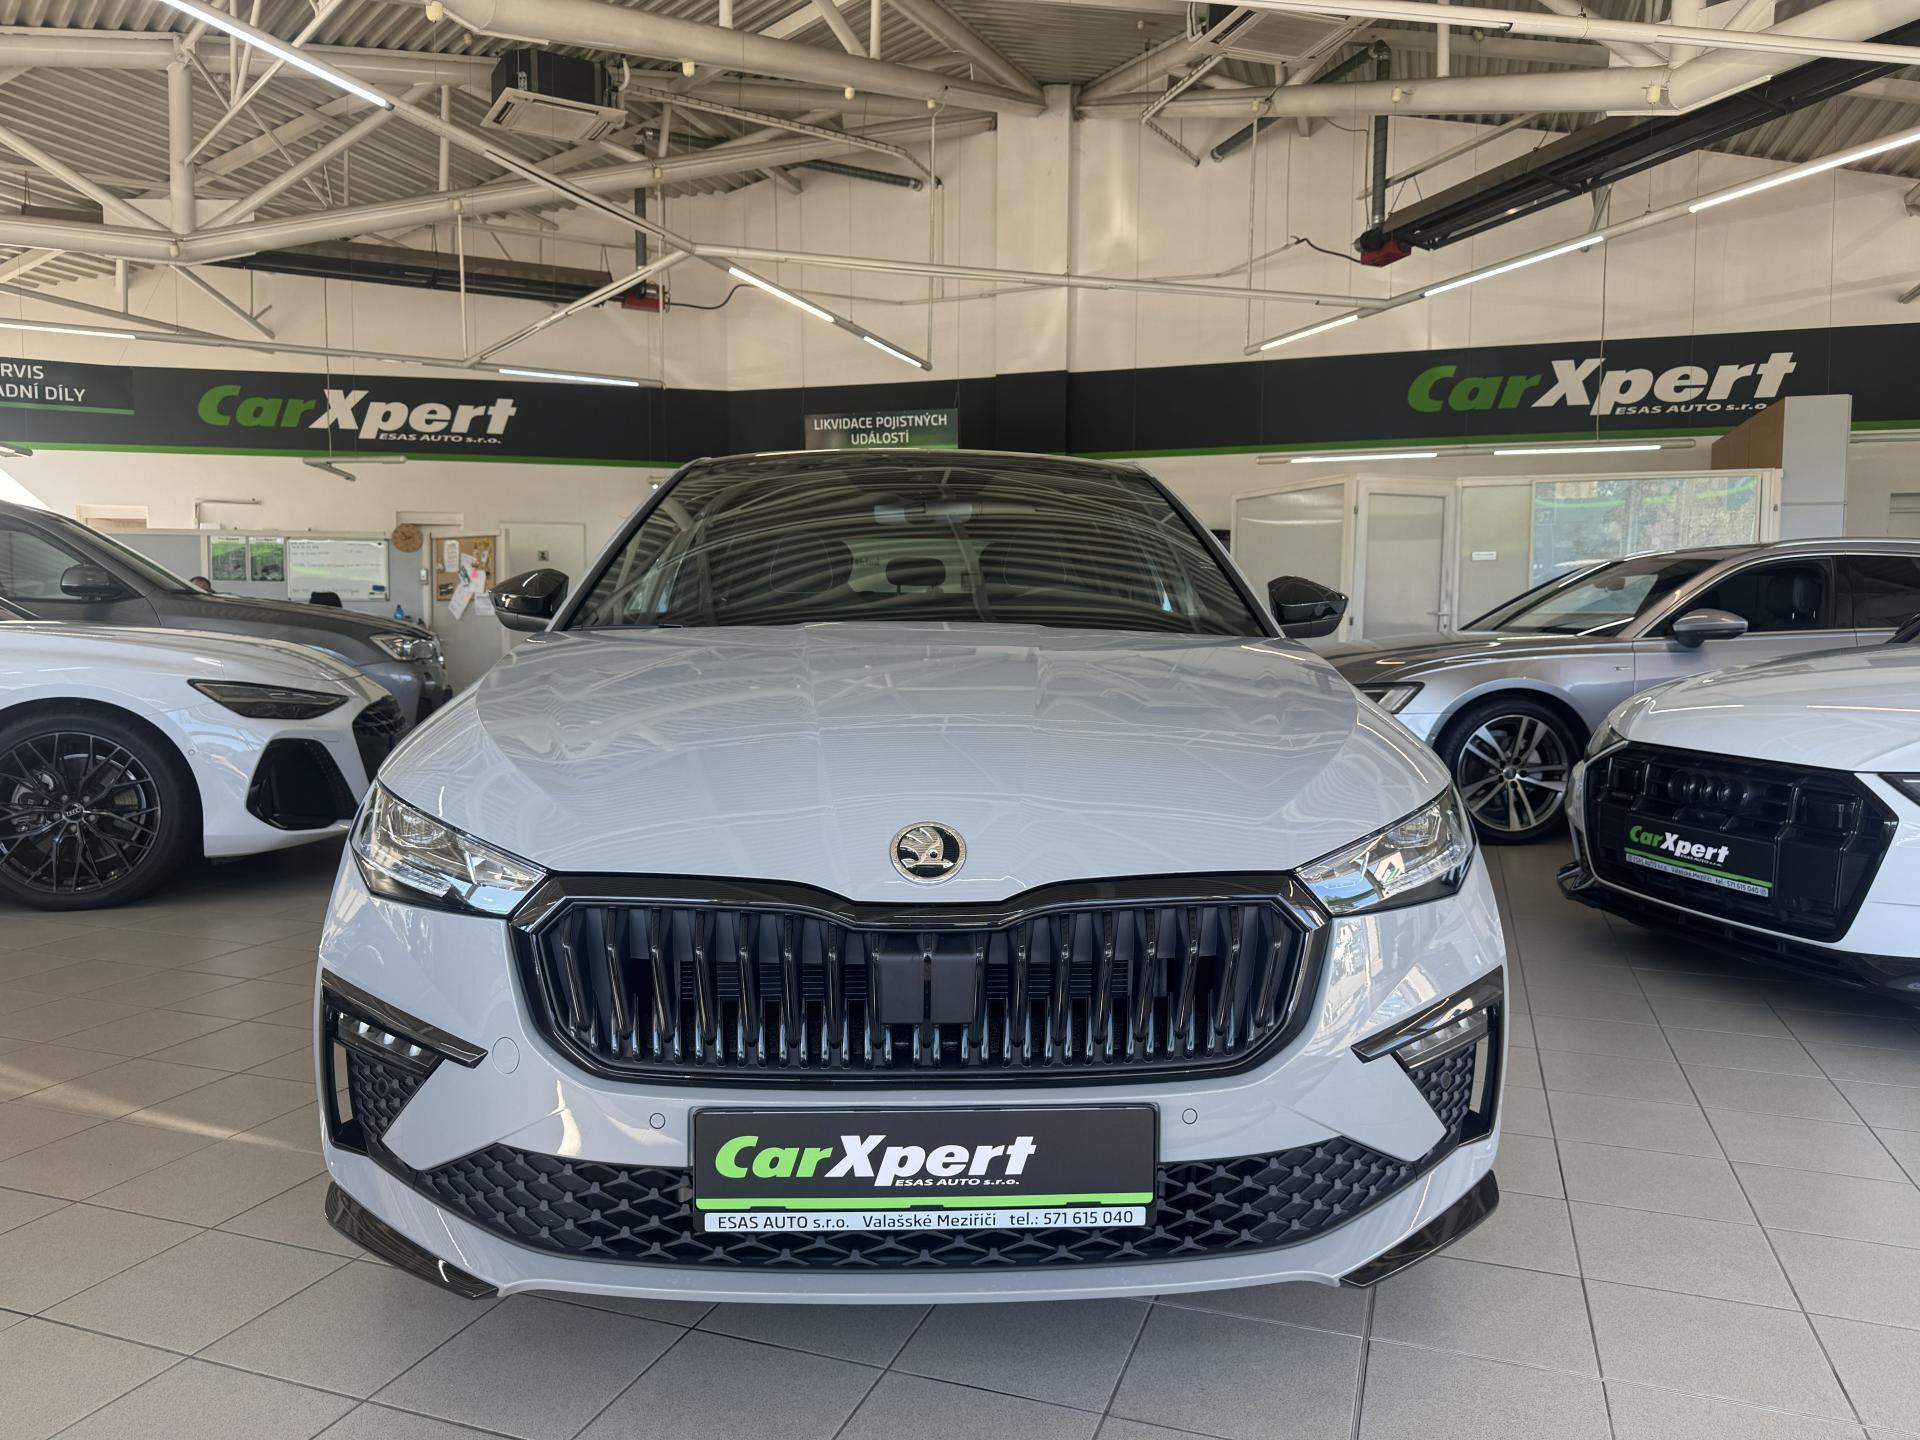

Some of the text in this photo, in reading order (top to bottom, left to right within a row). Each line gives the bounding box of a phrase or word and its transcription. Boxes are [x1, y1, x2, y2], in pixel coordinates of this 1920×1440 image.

[1407, 352, 1797, 416] CarXpert
[45, 385, 86, 402] DÍLY
[197, 384, 518, 440] CarXpert
[1615, 404, 1662, 415] ESAS
[1666, 403, 1721, 414] AUTO
[814, 412, 948, 431] LIKVIDACE POJISTNÝCH
[379, 432, 501, 444] ESAS AUTO s.r.o.
[851, 430, 909, 445] UDÁLOSTÍ
[1629, 825, 1729, 863] CarXpert
[1726, 879, 1736, 888] 571
[1737, 882, 1747, 891] 615
[715, 1134, 1037, 1187] CarXpert
[894, 1176, 1020, 1187] ESAS AUTO s.r.o.
[718, 1211, 1134, 1230] ESAS AUTO s.r.o. Valašské Meziříčí tel.: 571 615 040
